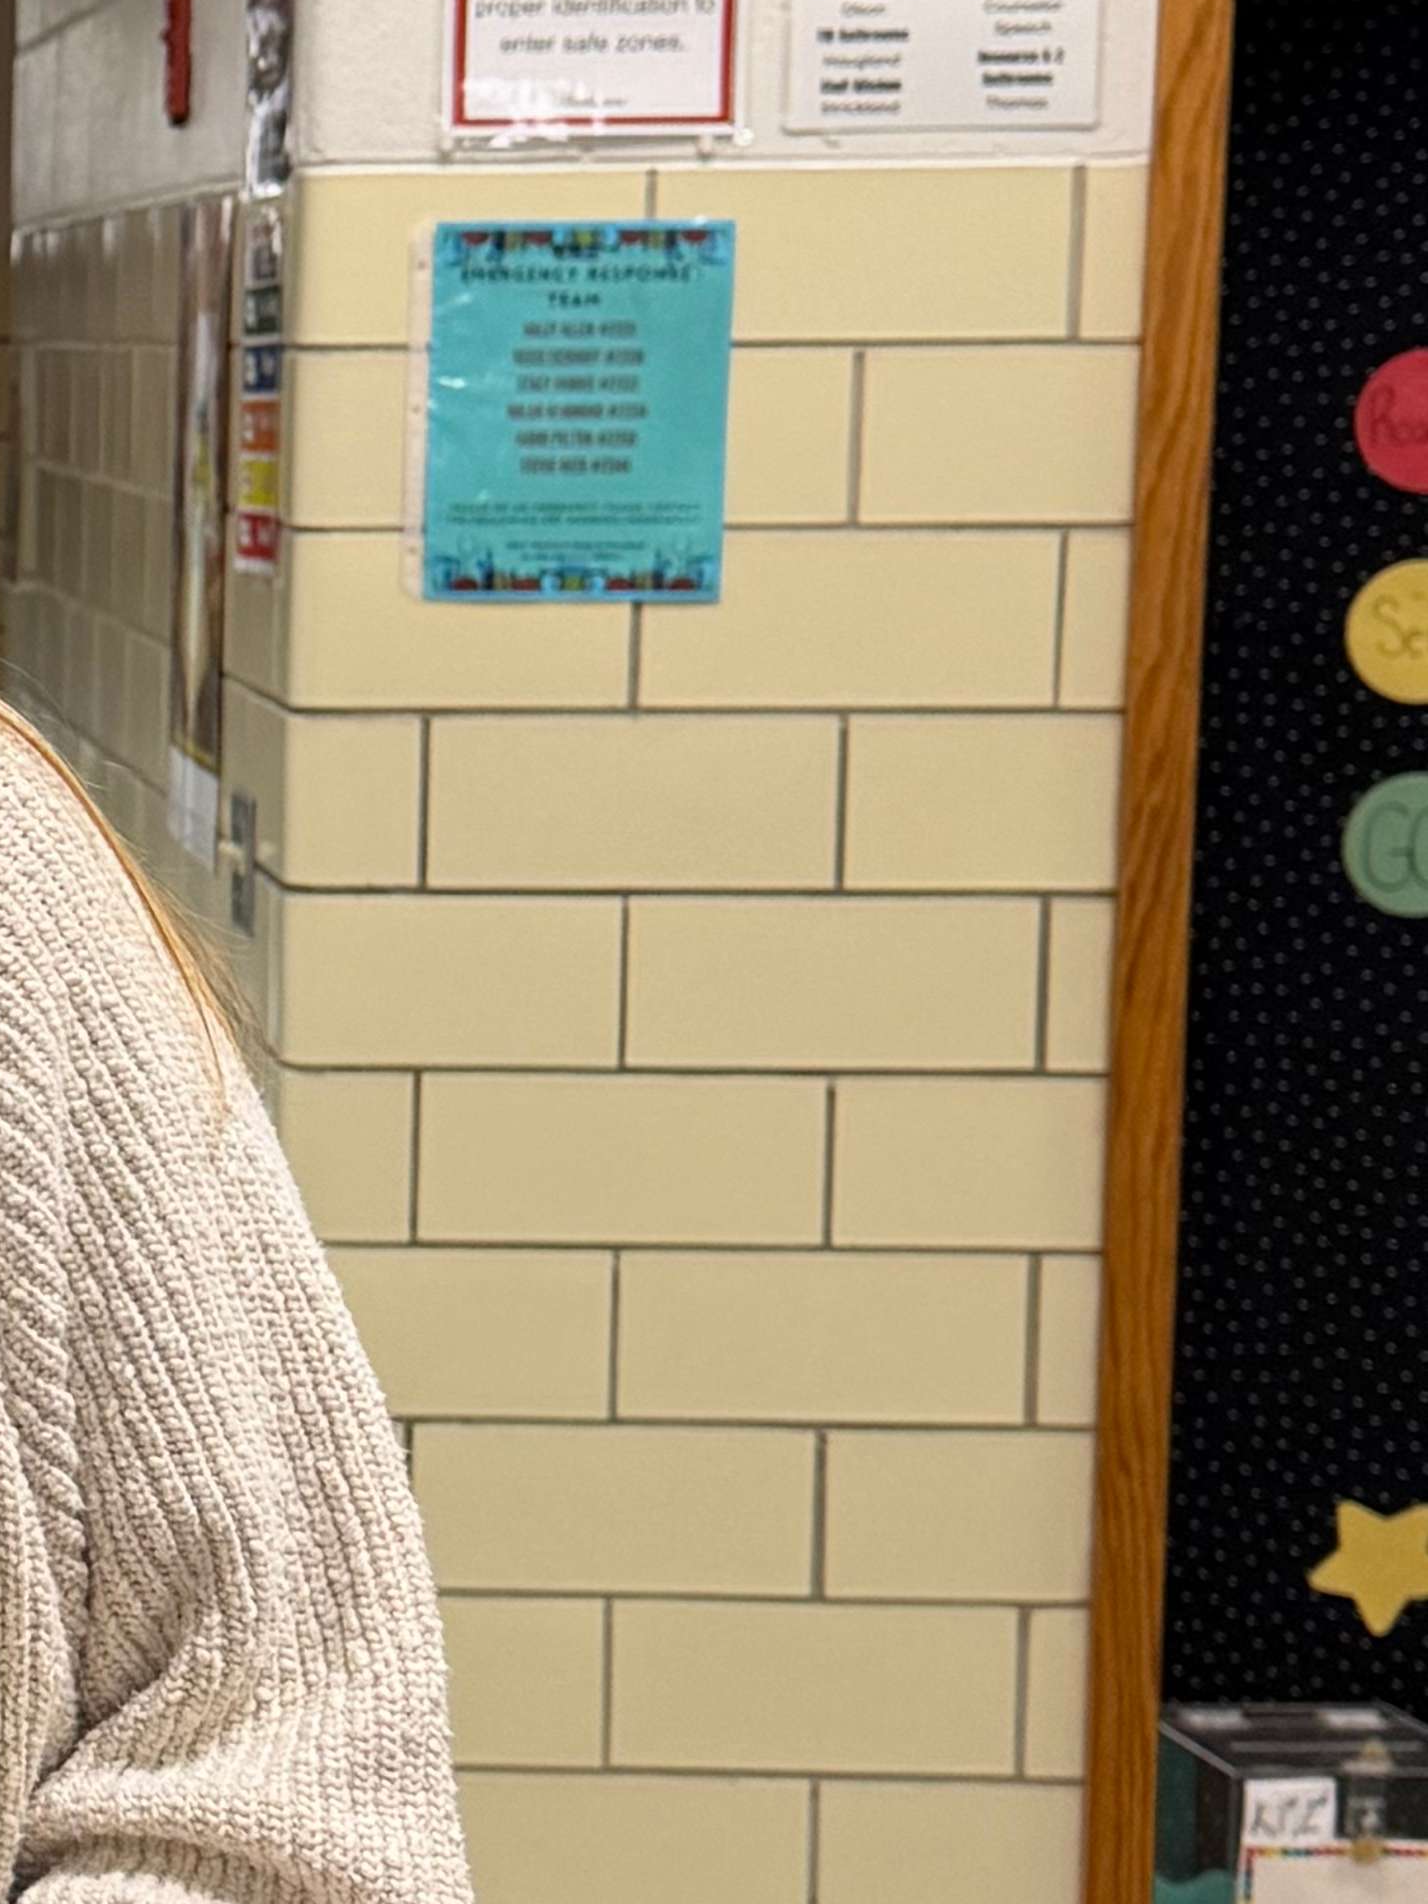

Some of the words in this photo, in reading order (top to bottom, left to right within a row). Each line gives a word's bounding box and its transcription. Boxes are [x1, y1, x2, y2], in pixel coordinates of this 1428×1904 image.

[474, 1, 545, 18] proper
[499, 37, 555, 53] enter
[562, 34, 608, 53] safe
[548, 293, 601, 308] TEAM
